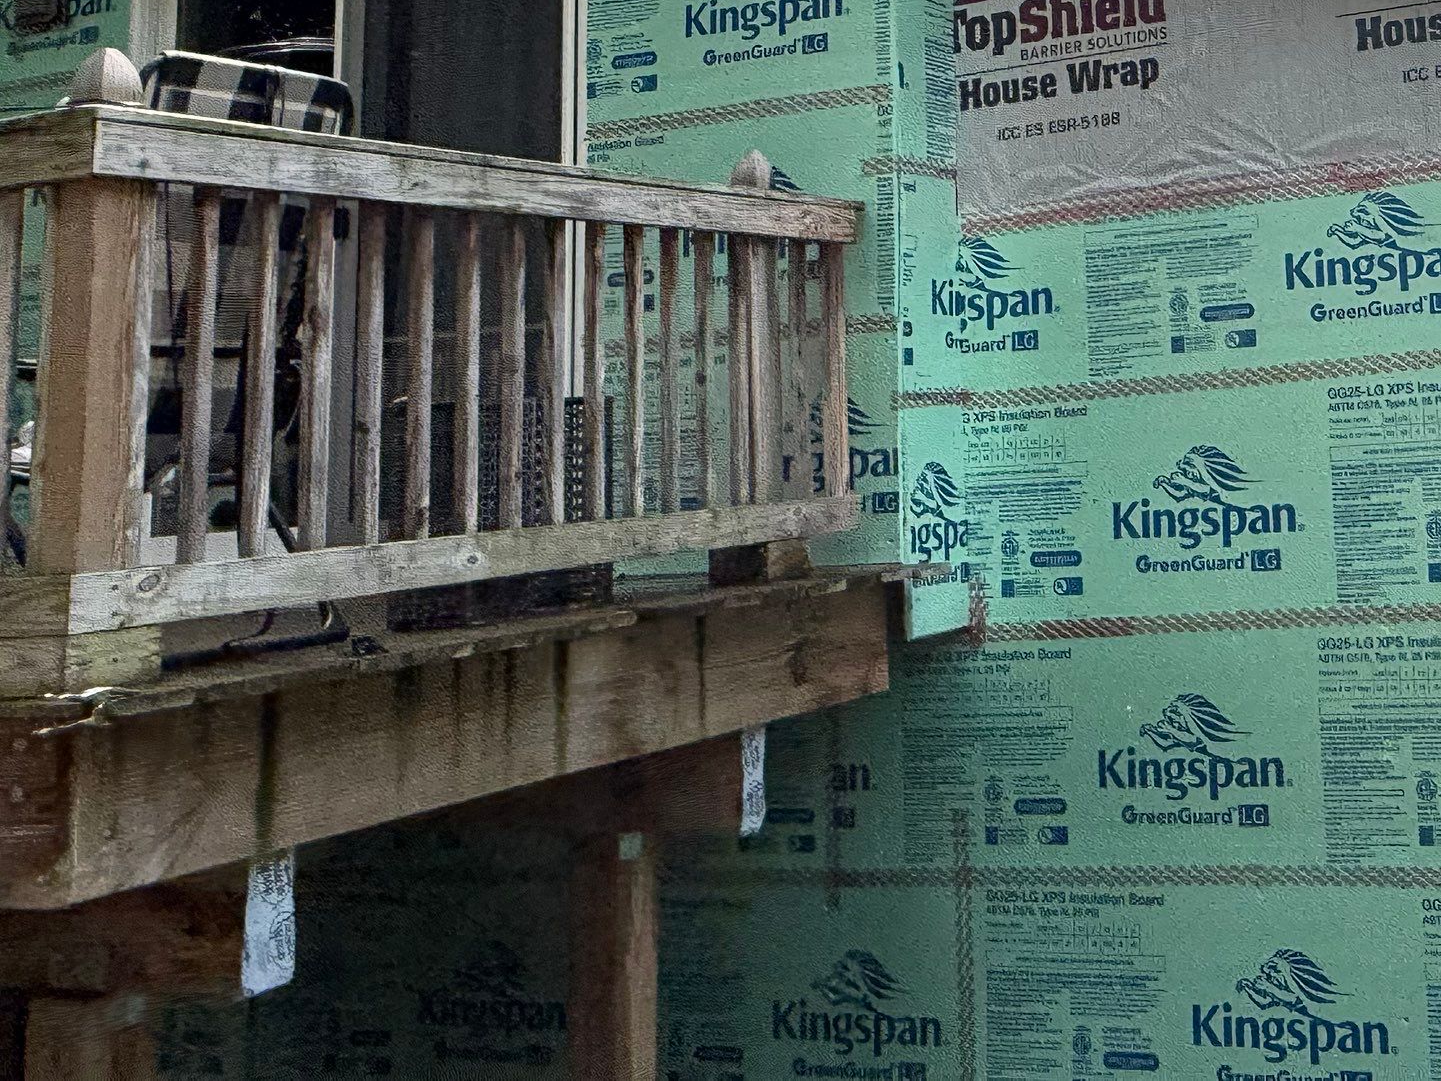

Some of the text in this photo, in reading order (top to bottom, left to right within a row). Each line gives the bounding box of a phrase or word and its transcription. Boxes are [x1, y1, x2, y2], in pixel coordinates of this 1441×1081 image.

[703, 33, 828, 66] GreenGuard LG
[1020, 26, 1168, 61] BARRIER SOLUTIONS
[960, 56, 1160, 112] House Wrap
[1402, 68, 1429, 83] ICC
[1310, 298, 1424, 322] GreenGuard
[1012, 330, 1038, 351] LG
[1388, 381, 1415, 395] XPS
[1112, 498, 1297, 549] Kingspan
[1136, 550, 1281, 575] GreenGuard LG
[1098, 746, 1286, 800] Kingspan
[1121, 804, 1269, 827] GreenGuard LG
[771, 1000, 942, 1057] Kingspan
[1192, 1002, 1390, 1065] Kingspan
